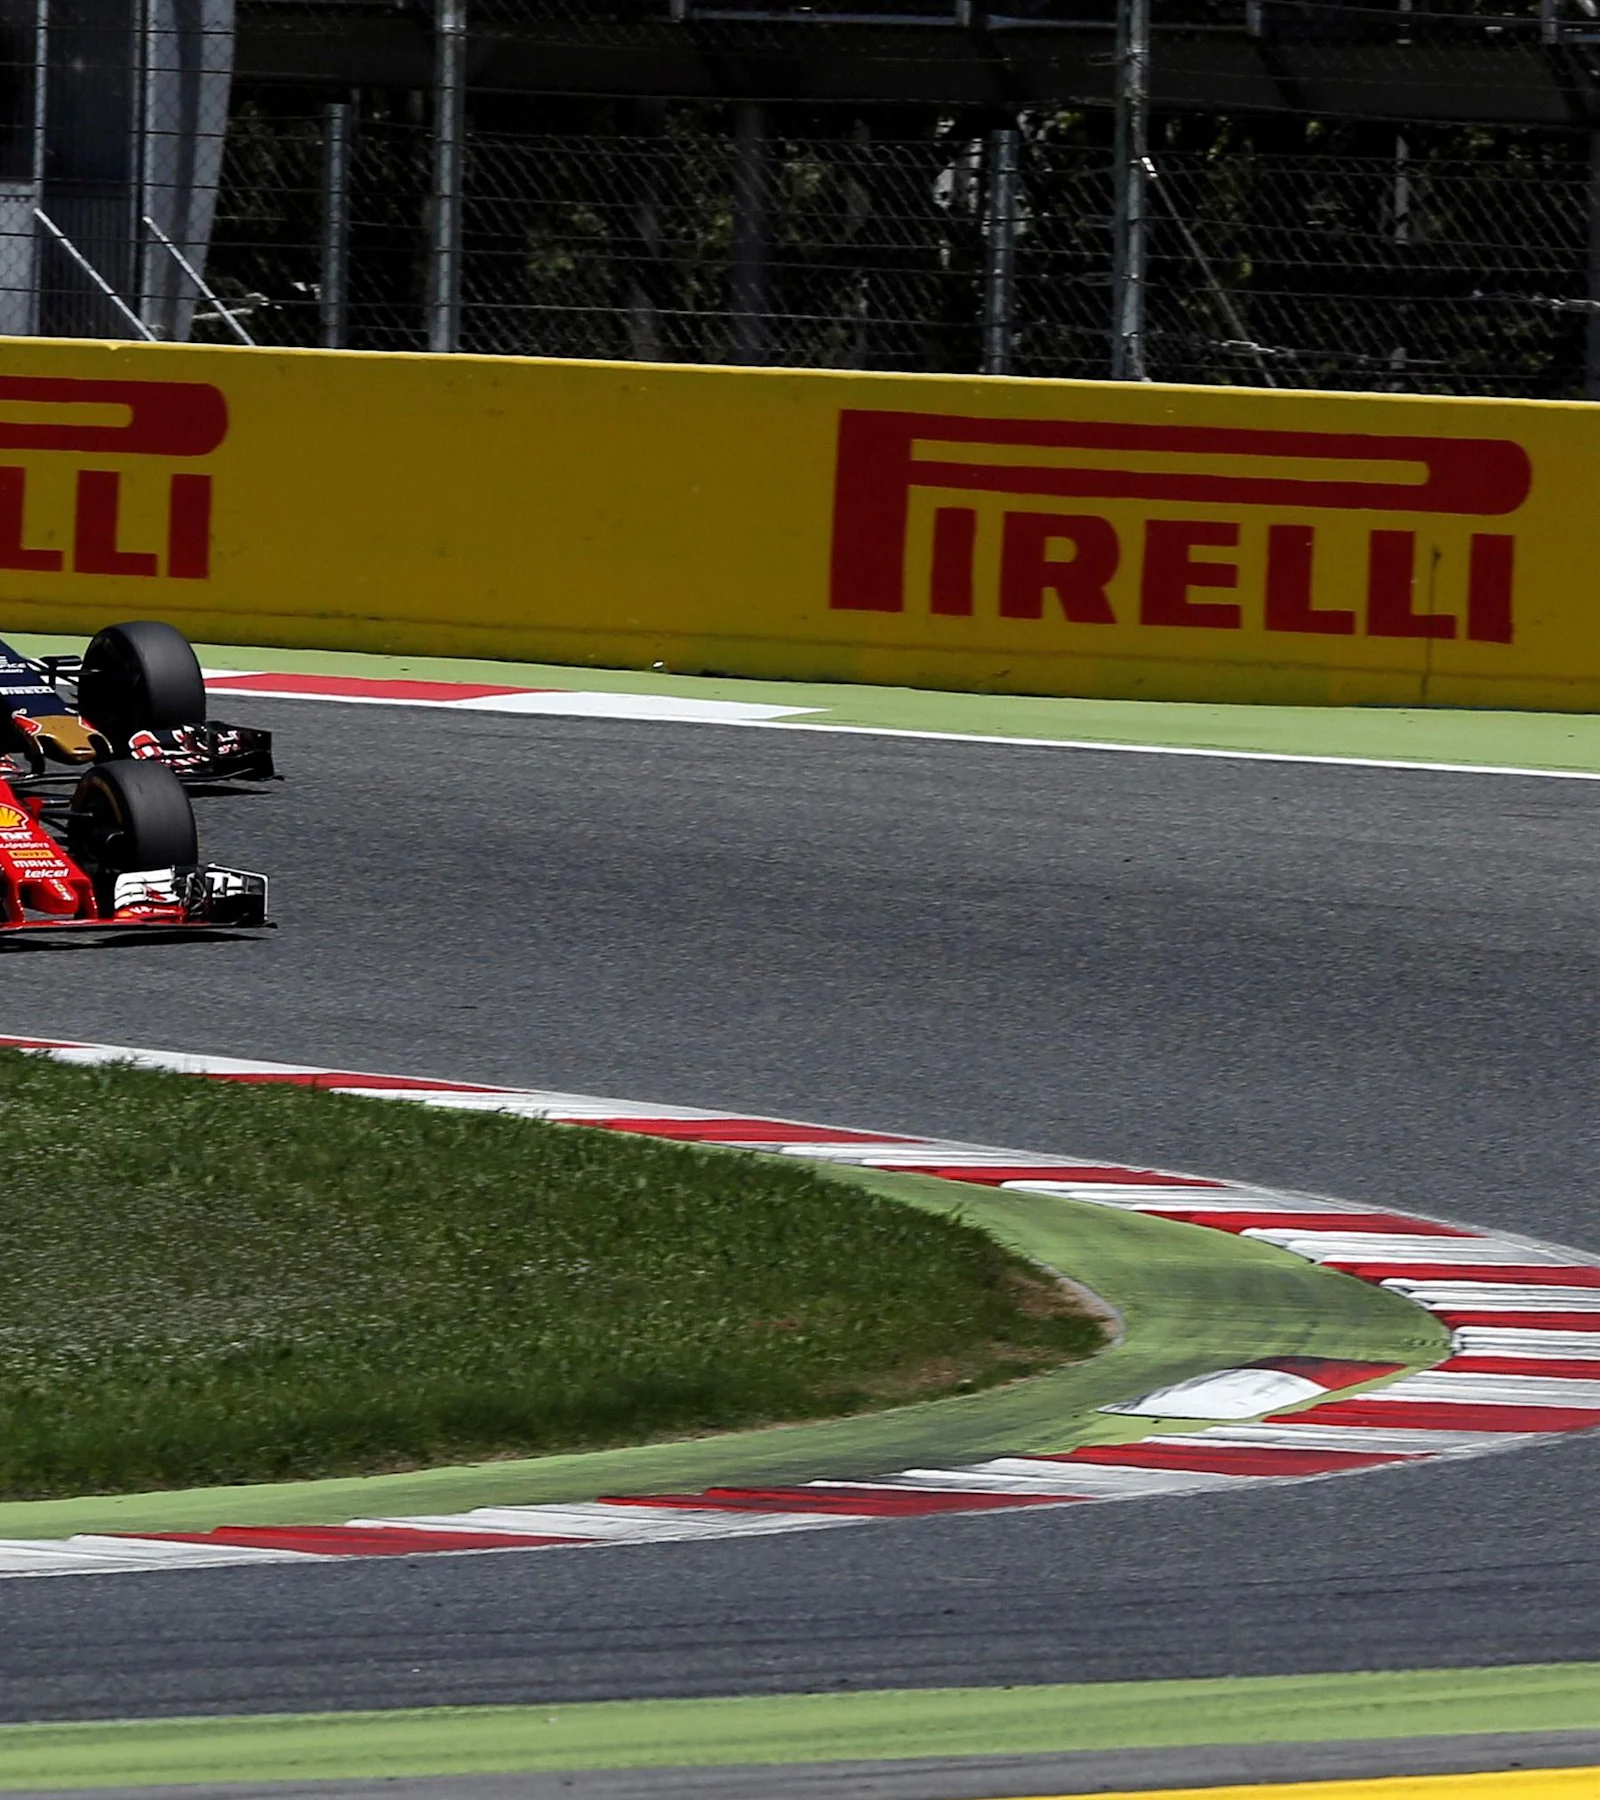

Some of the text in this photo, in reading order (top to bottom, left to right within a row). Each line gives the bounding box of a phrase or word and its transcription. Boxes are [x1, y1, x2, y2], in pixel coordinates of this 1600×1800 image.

[829, 409, 1532, 644] PIRELLI
[11, 859, 67, 869] MAHLE
[24, 868, 70, 879] telcel
